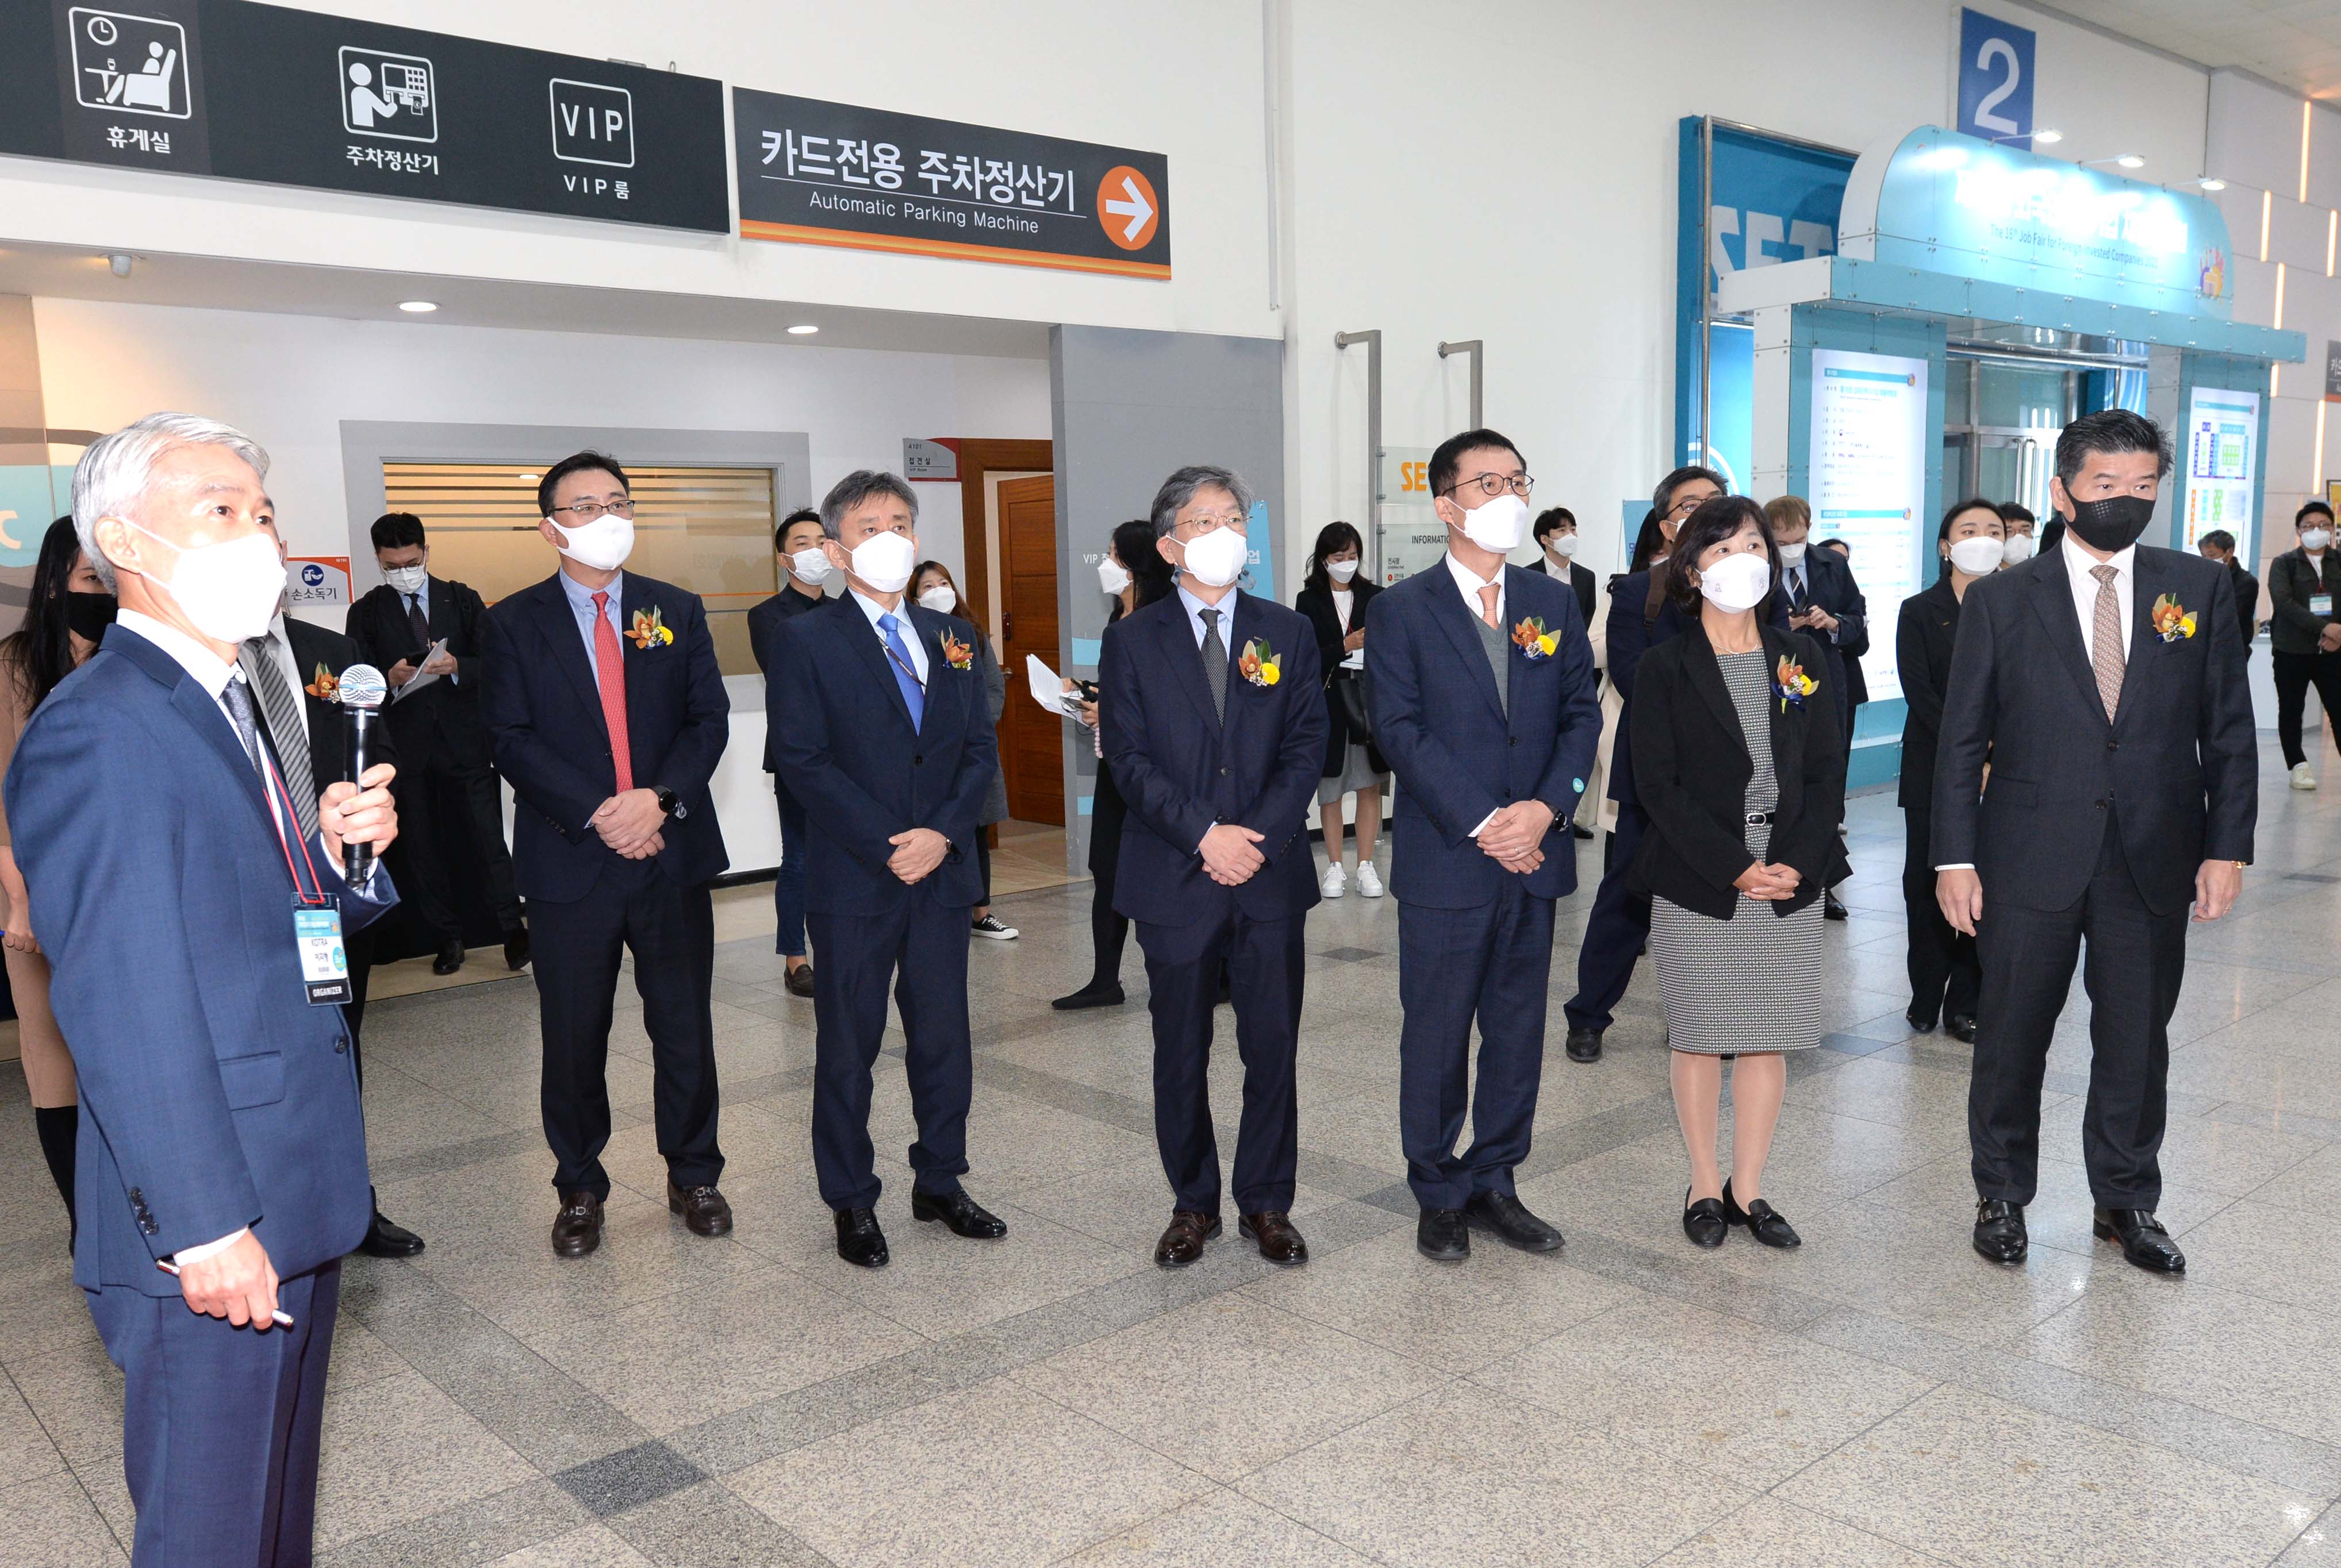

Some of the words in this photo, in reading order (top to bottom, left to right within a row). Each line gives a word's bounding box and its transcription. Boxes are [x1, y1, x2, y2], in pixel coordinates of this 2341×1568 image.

[1974, 37, 2020, 136] 2
[561, 102, 624, 143] VIP
[106, 126, 171, 154] 휴게실
[346, 145, 439, 176] 주차정산기
[762, 128, 905, 190] 카드전용
[917, 149, 1076, 212] 주차정산기
[809, 192, 896, 218] Automatic
[904, 202, 966, 228] Parking
[974, 211, 1039, 235] Machine
[1991, 224, 2004, 239] The
[2019, 230, 2031, 244] Job
[2033, 233, 2046, 248] Fair
[2048, 236, 2056, 249] for
[2110, 249, 2144, 267] Companies
[1401, 462, 1429, 491] SE
[1083, 554, 1098, 564] VIP
[291, 587, 337, 601] 손소독기
[312, 985, 343, 997] ORGANIZER
